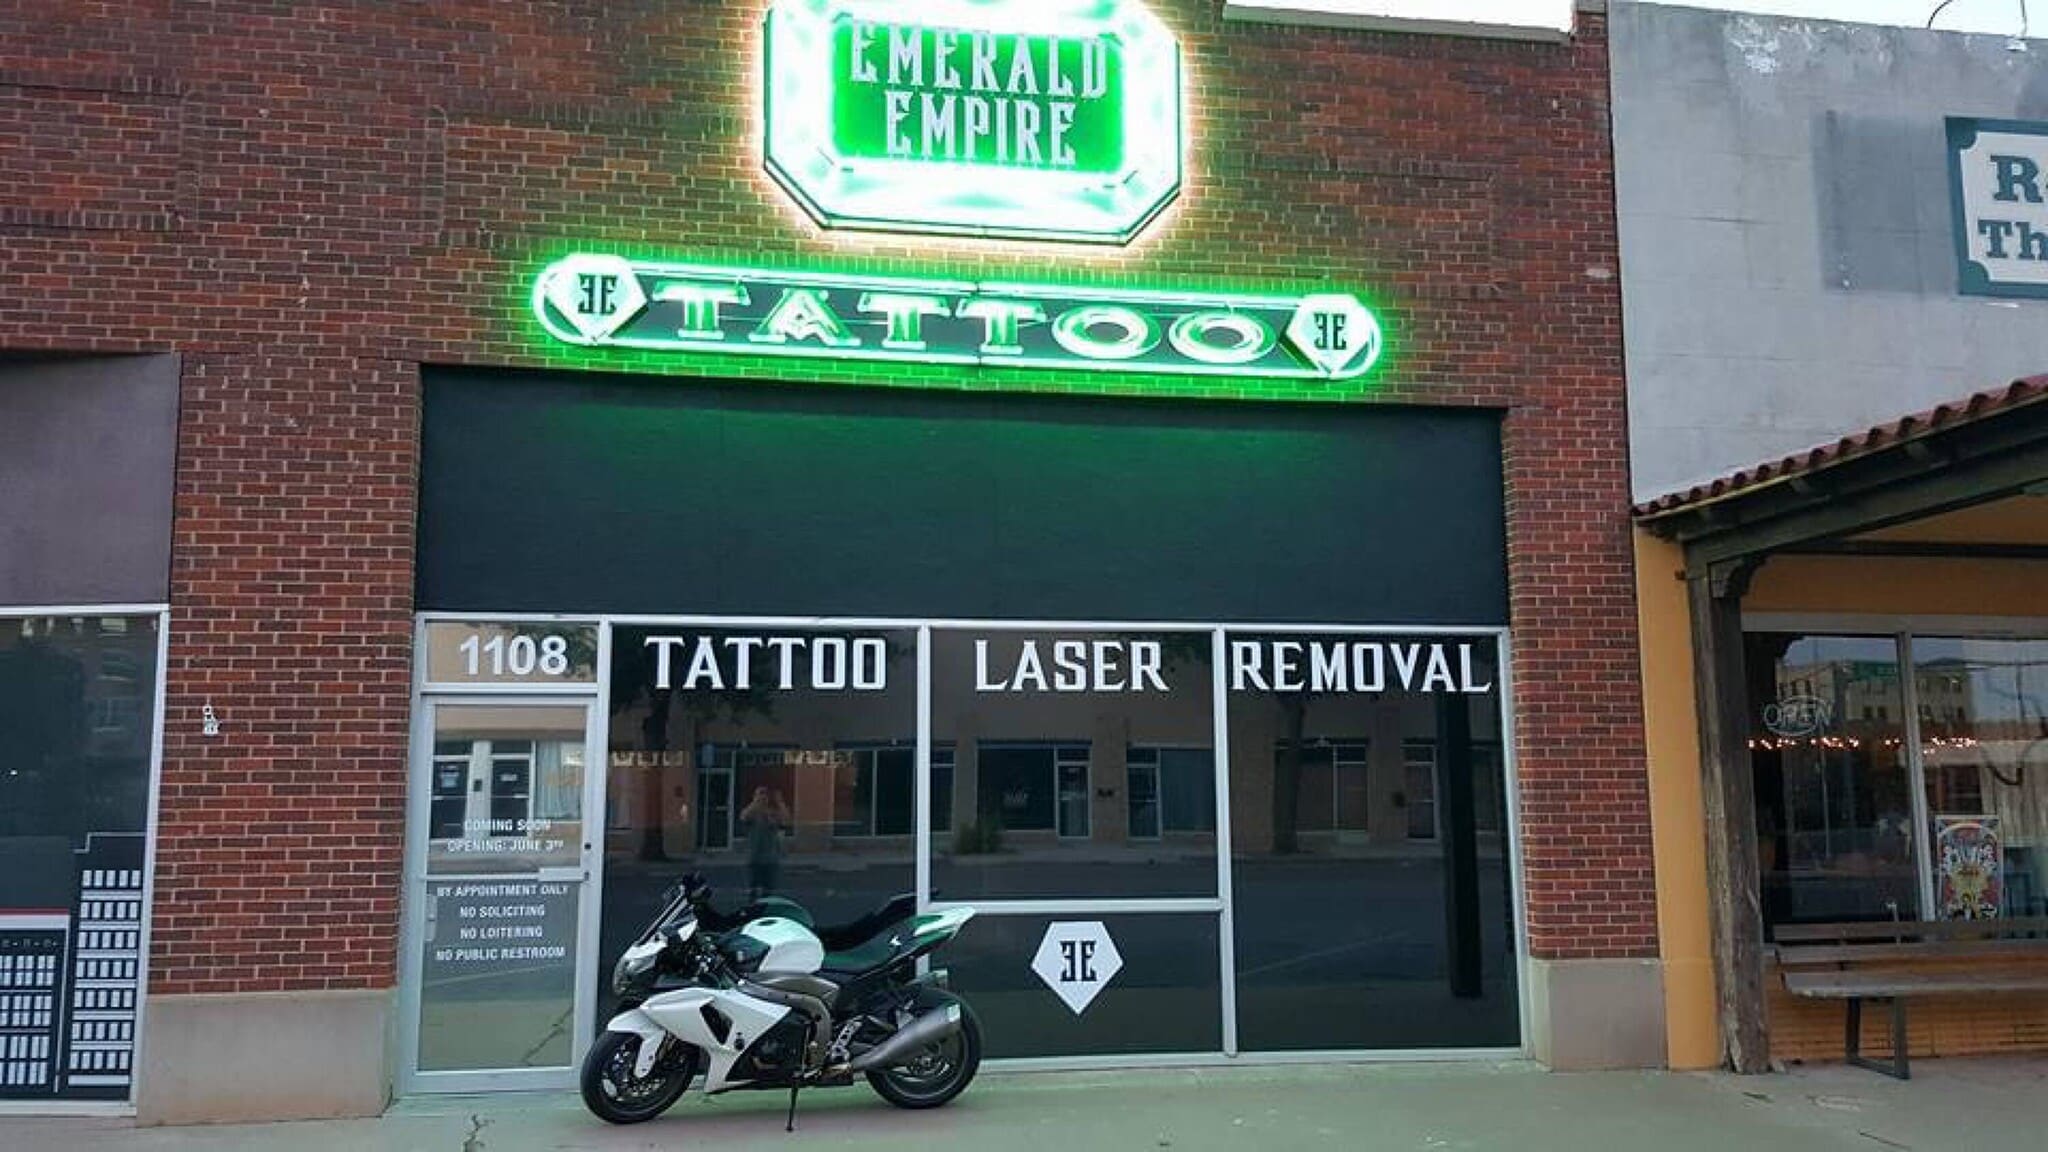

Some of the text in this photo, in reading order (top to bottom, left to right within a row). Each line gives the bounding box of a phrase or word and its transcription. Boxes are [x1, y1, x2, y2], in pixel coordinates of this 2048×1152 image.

[851, 19, 1108, 99] EMERALD
[885, 90, 1076, 167] EMPIRE
[652, 280, 1277, 363] TATTOO
[460, 635, 569, 677] 1108
[645, 636, 1492, 693] TATTOO LASER REMOVAL
[464, 819, 551, 831] COMING SOON
[511, 839, 539, 851] JUNE
[437, 884, 569, 897] BY APPOINTMENT ONLY
[460, 904, 545, 918] NO SOLICITING
[460, 925, 543, 939] NO LOITERING
[436, 946, 565, 960] NO PUBLIC RESTROOM
